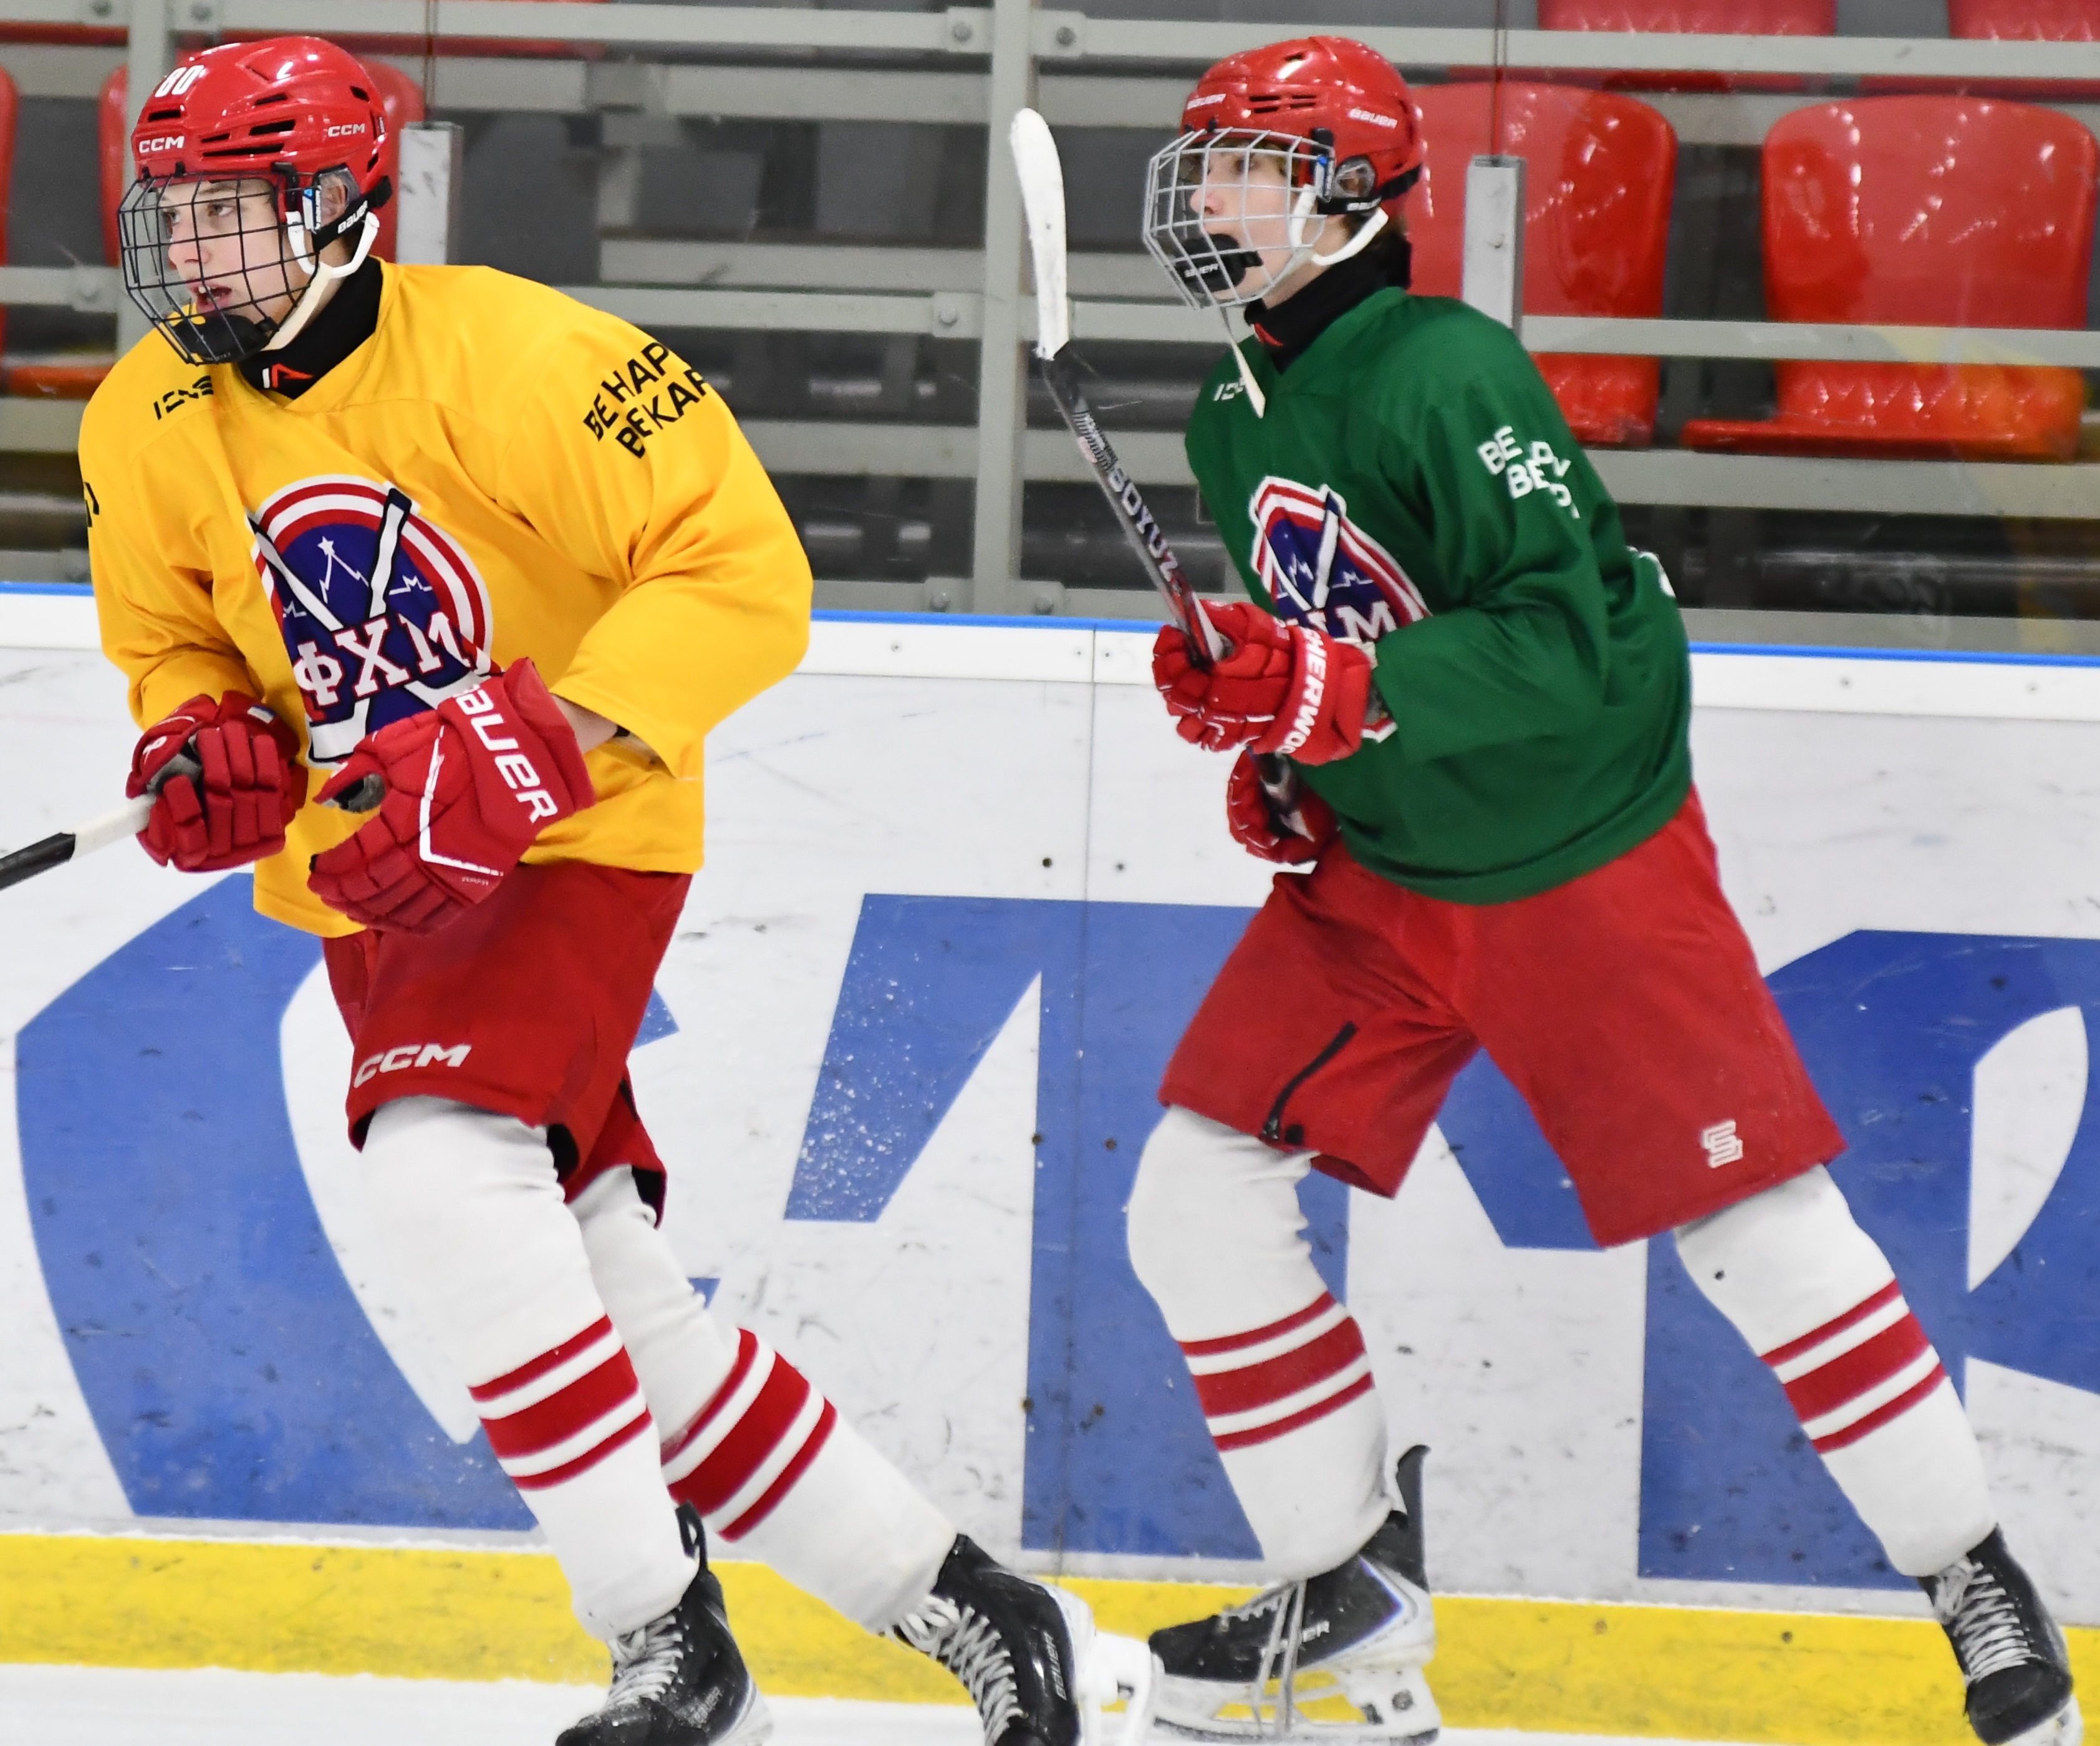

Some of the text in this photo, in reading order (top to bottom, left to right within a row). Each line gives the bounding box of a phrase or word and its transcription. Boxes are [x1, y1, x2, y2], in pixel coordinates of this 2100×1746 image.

[155, 65, 205, 97] 80
[138, 135, 185, 153] CCM
[328, 123, 365, 137] CCM
[451, 684, 559, 824] AUER
[353, 1043, 473, 1089] CCM
